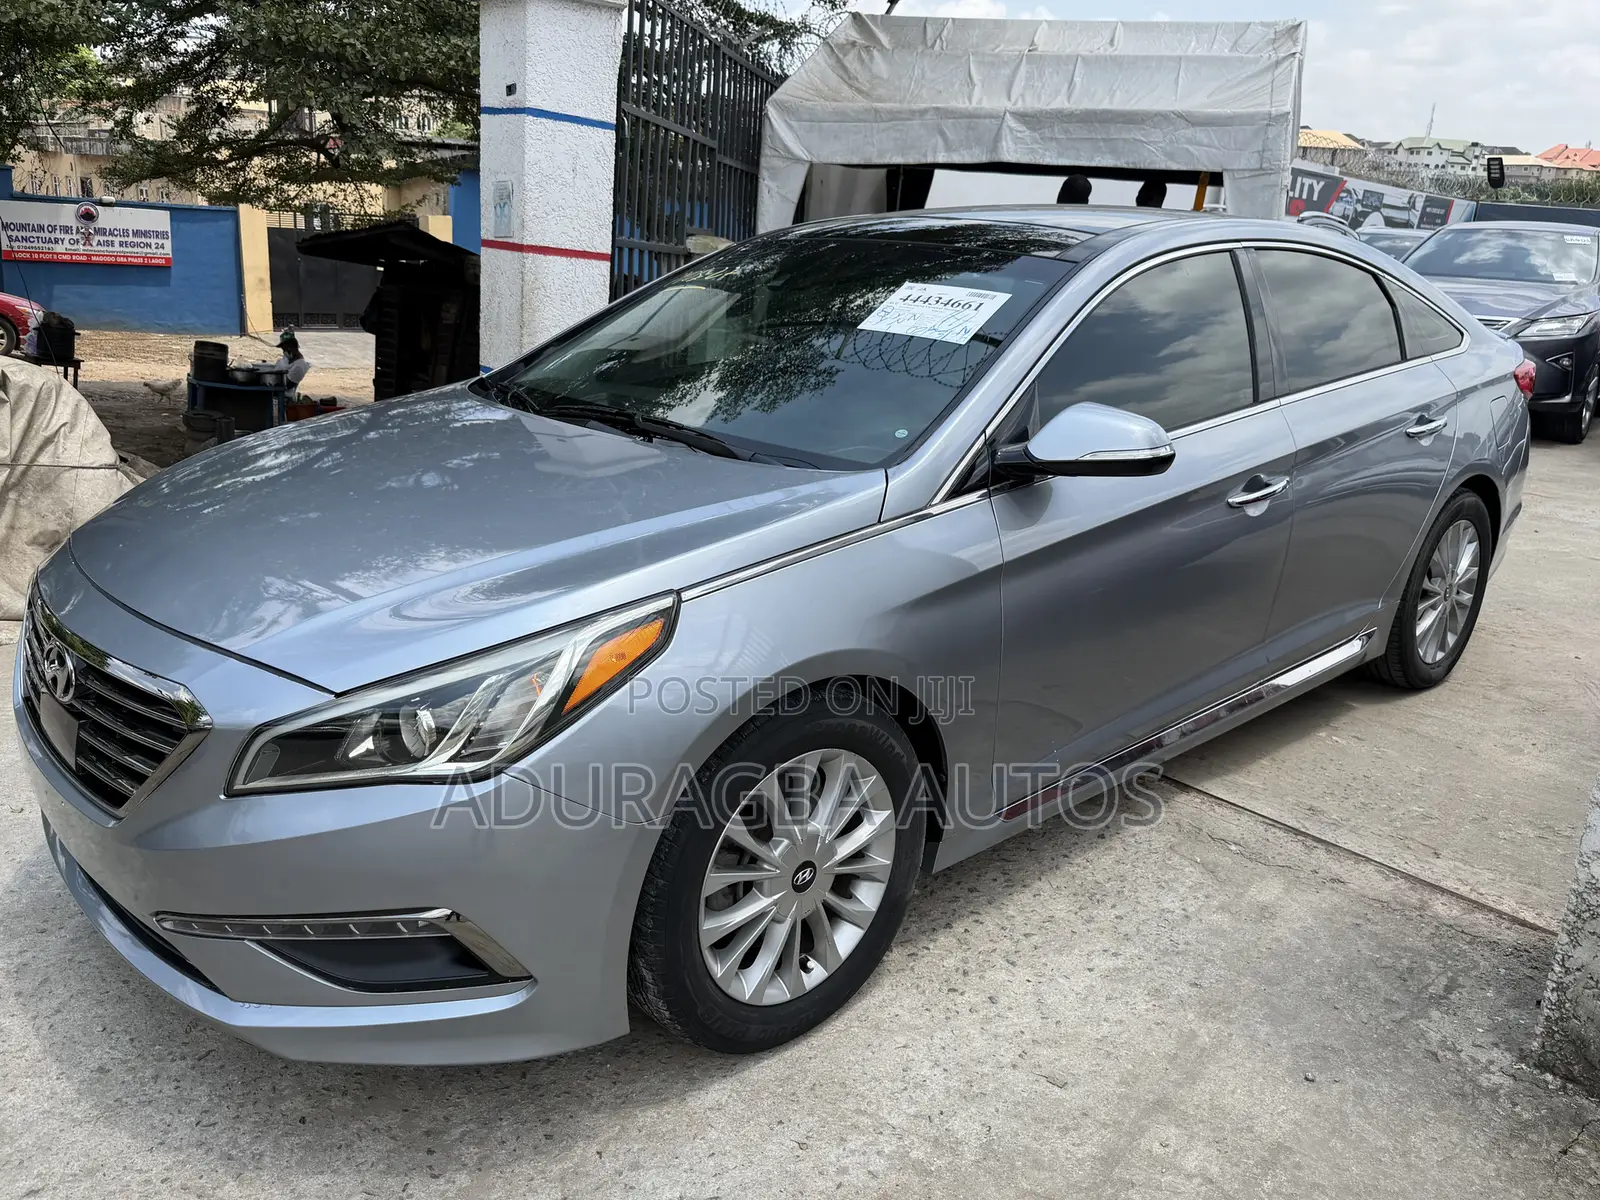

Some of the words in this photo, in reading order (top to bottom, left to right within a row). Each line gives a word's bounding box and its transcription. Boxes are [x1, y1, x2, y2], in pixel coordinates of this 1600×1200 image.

[1, 221, 46, 234] MOUNTAIN
[46, 224, 58, 234] OF
[59, 224, 74, 236] FIRE
[93, 226, 130, 238] MIRACLES
[131, 228, 170, 240] MINISTRIES
[8, 234, 66, 245] SANCTUARY
[68, 237, 80, 246] OF
[118, 240, 152, 249] REGION
[154, 241, 165, 251] 24
[128, 256, 143, 264] PHASE
[899, 293, 984, 312] 44434661
